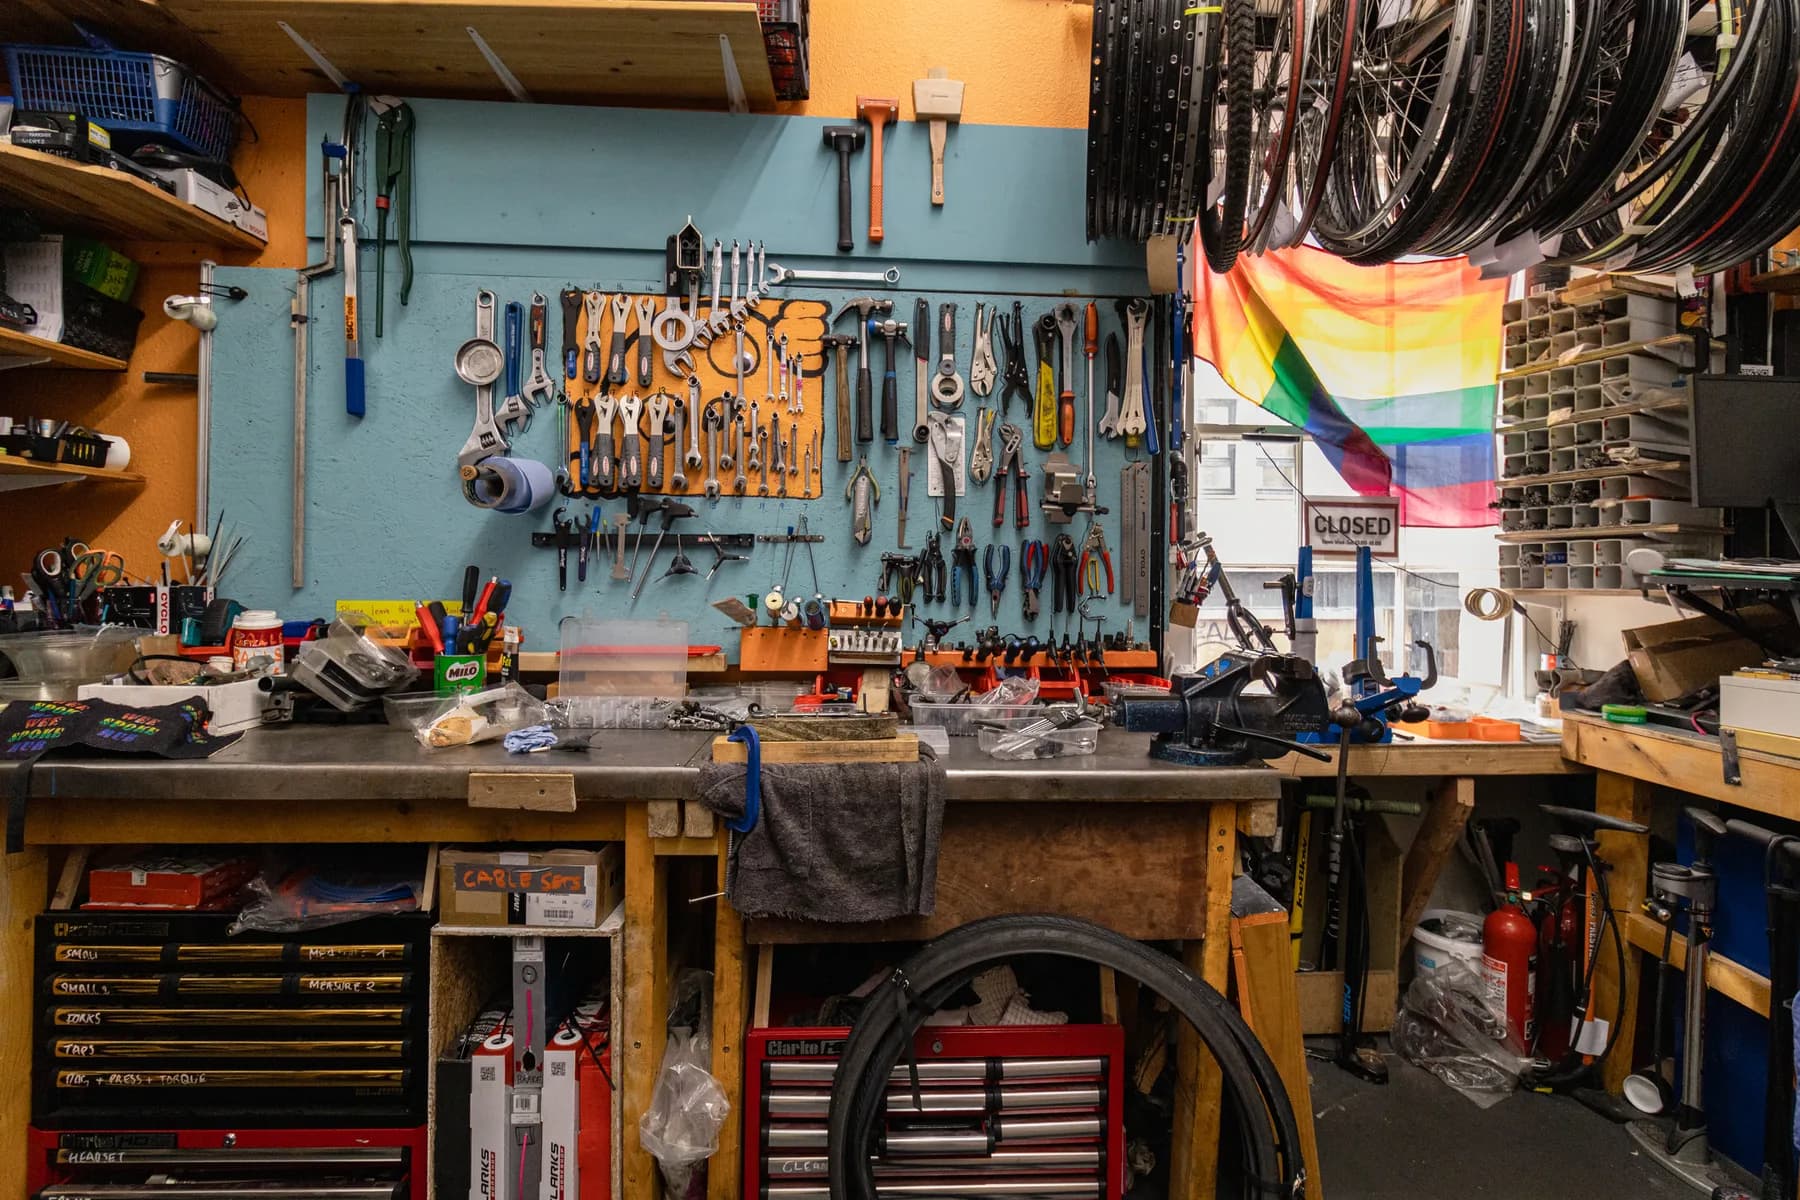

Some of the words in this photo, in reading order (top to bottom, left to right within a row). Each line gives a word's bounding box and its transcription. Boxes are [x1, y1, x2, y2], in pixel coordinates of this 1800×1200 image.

[1315, 515, 1391, 536] CLOSED
[160, 592, 168, 634] CYCLO
[448, 666, 478, 678] MILO
[30, 701, 83, 716] SPOK
[25, 715, 62, 729] WEE
[121, 712, 161, 726] WEE
[97, 717, 161, 736] SPOKE
[7, 727, 66, 743] SPOKE
[463, 868, 531, 889] CABLE
[309, 980, 361, 992] MEASURE
[366, 982, 376, 992] 2
[66, 1012, 101, 1025] FORKS
[63, 1044, 95, 1056] TAPS
[767, 1040, 818, 1056] Clarke
[109, 1073, 143, 1085] PRESS
[160, 1073, 207, 1086] TORQUE
[68, 1151, 125, 1163] HEADSET
[550, 1142, 559, 1200] LARKS
